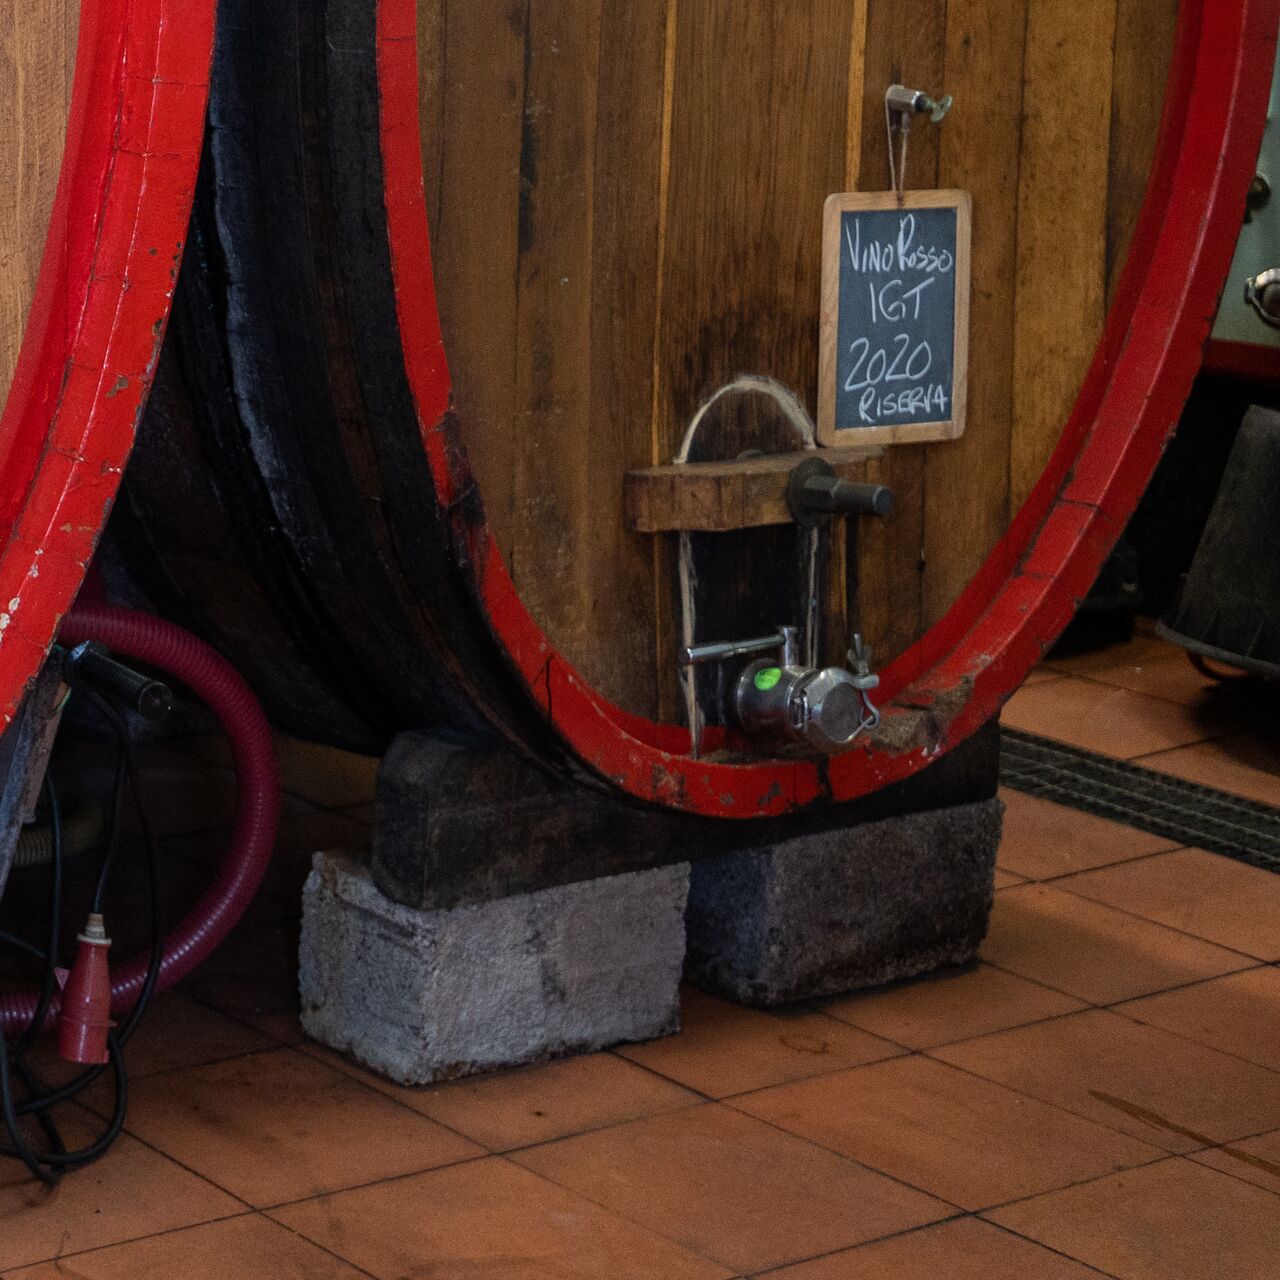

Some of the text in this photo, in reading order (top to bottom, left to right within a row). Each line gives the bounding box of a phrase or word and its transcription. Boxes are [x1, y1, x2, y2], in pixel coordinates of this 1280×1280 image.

[870, 276, 936, 323] IGT
[844, 333, 932, 391] 2020
[858, 384, 949, 424] RISERVA
